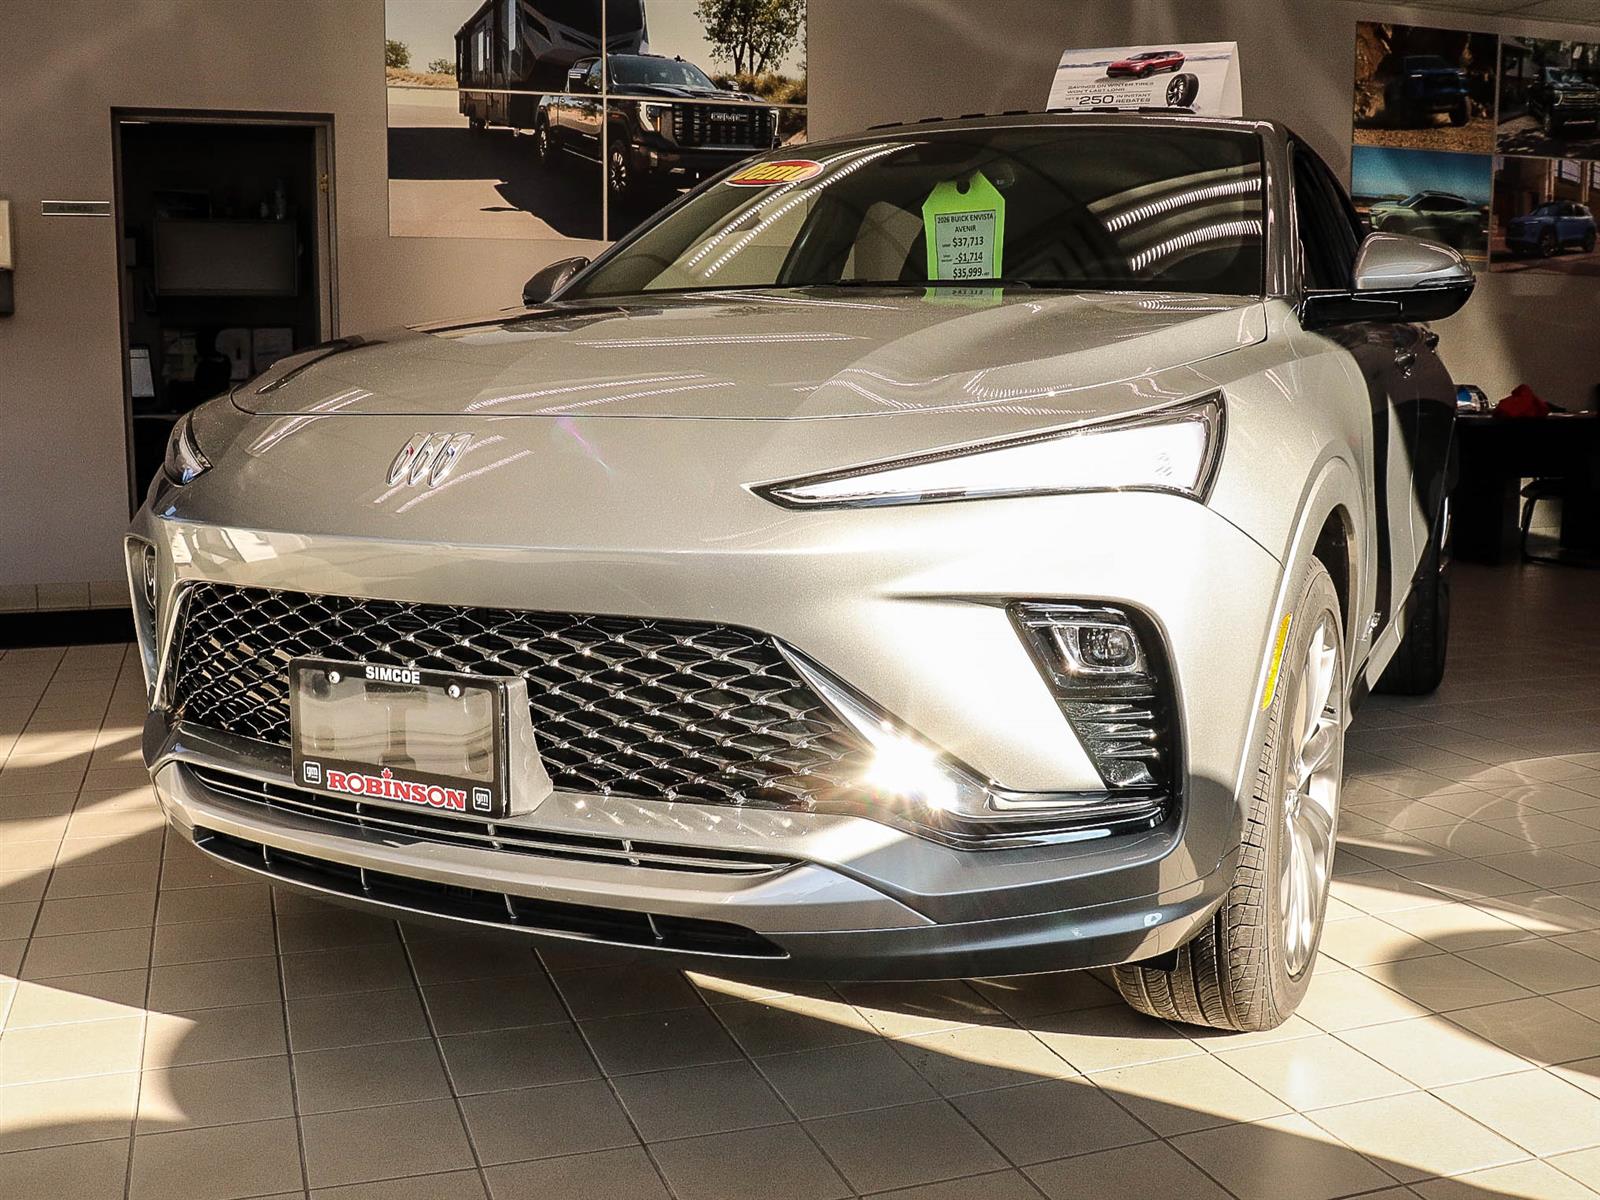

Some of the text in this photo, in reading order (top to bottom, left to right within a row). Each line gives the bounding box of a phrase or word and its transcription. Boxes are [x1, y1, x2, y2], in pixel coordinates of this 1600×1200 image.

[937, 216, 950, 224] 2026
[970, 213, 994, 221] ENVISTA
[955, 225, 977, 233] AVENIR
[952, 236, 984, 248] $37,713
[955, 252, 984, 263] -$1,714
[365, 666, 421, 685] SIMCOE
[327, 769, 467, 811] ROBINSON
